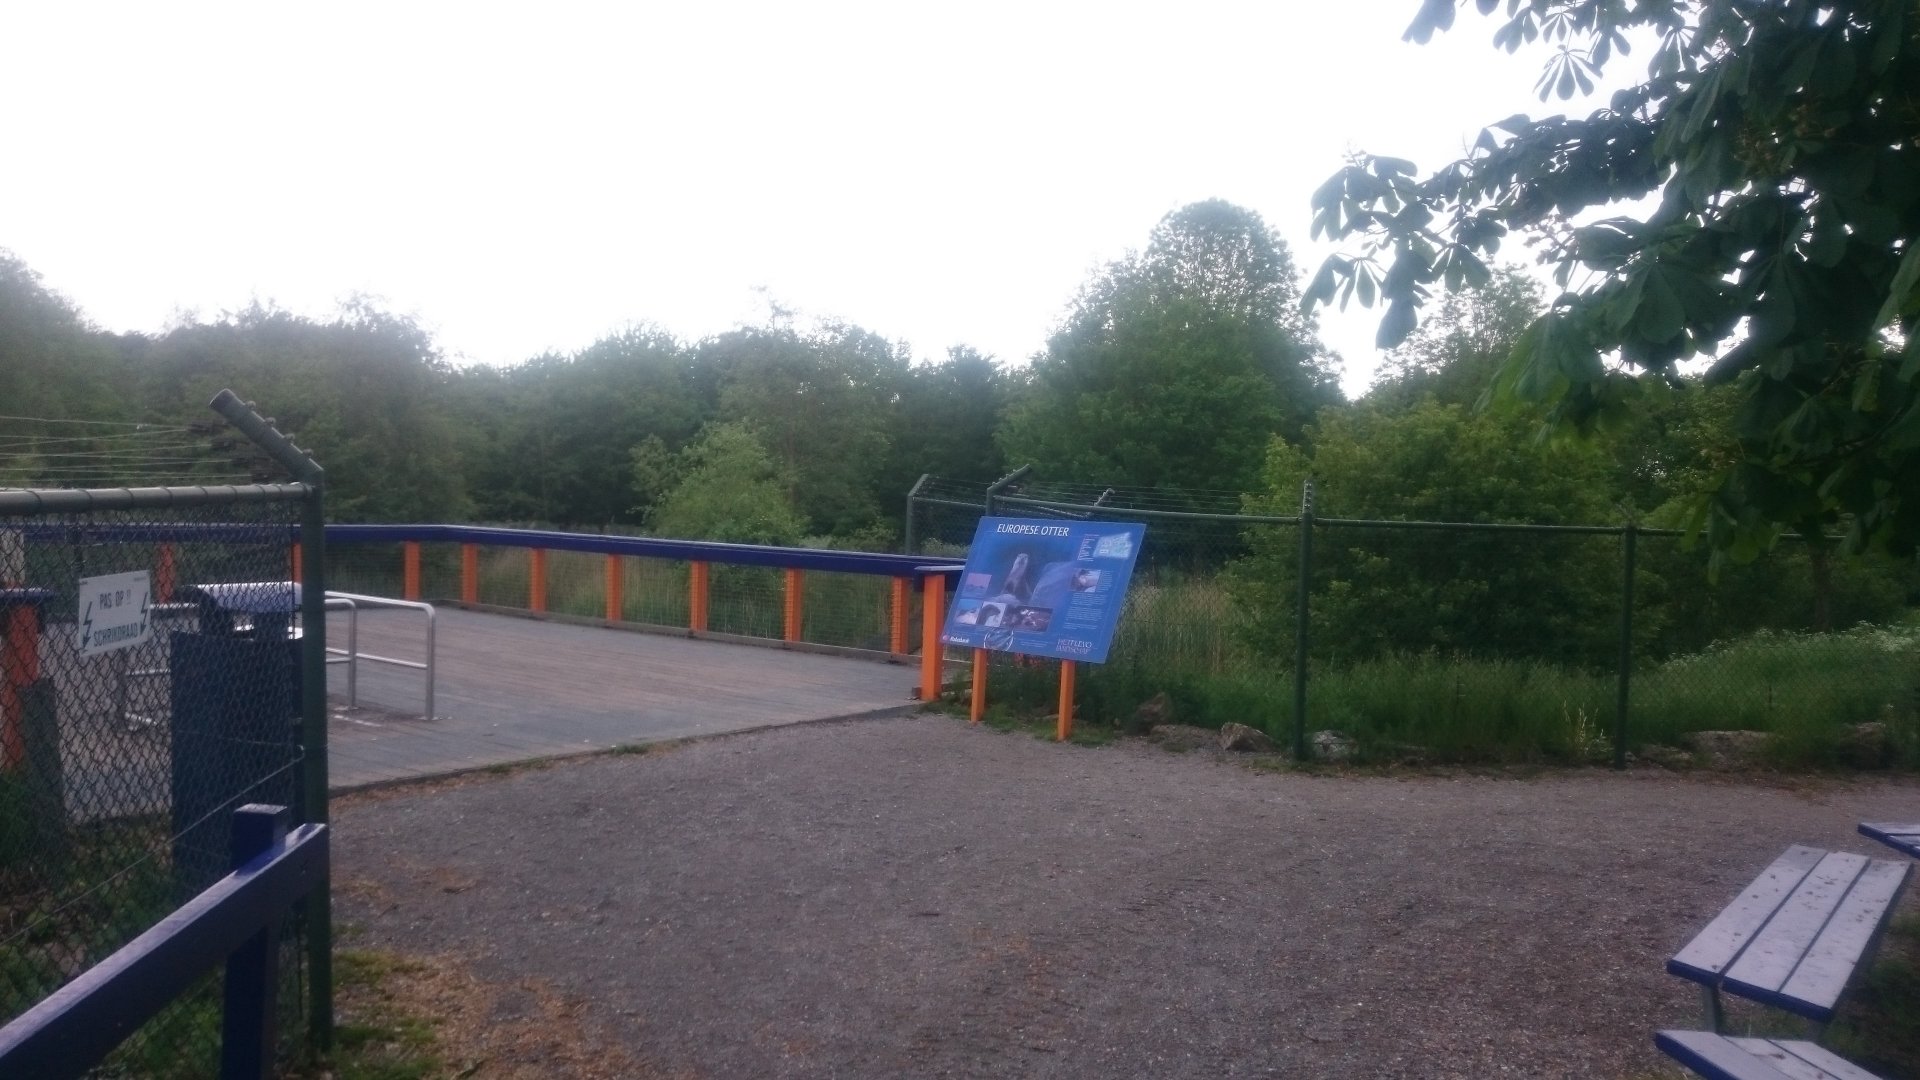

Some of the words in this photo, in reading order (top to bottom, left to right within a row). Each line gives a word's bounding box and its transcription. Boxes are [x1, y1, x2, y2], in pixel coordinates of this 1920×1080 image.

[997, 523, 1040, 535] EUROPESE
[1041, 526, 1070, 537] OTTER
[100, 592, 112, 610] PAS
[116, 590, 125, 607] OP
